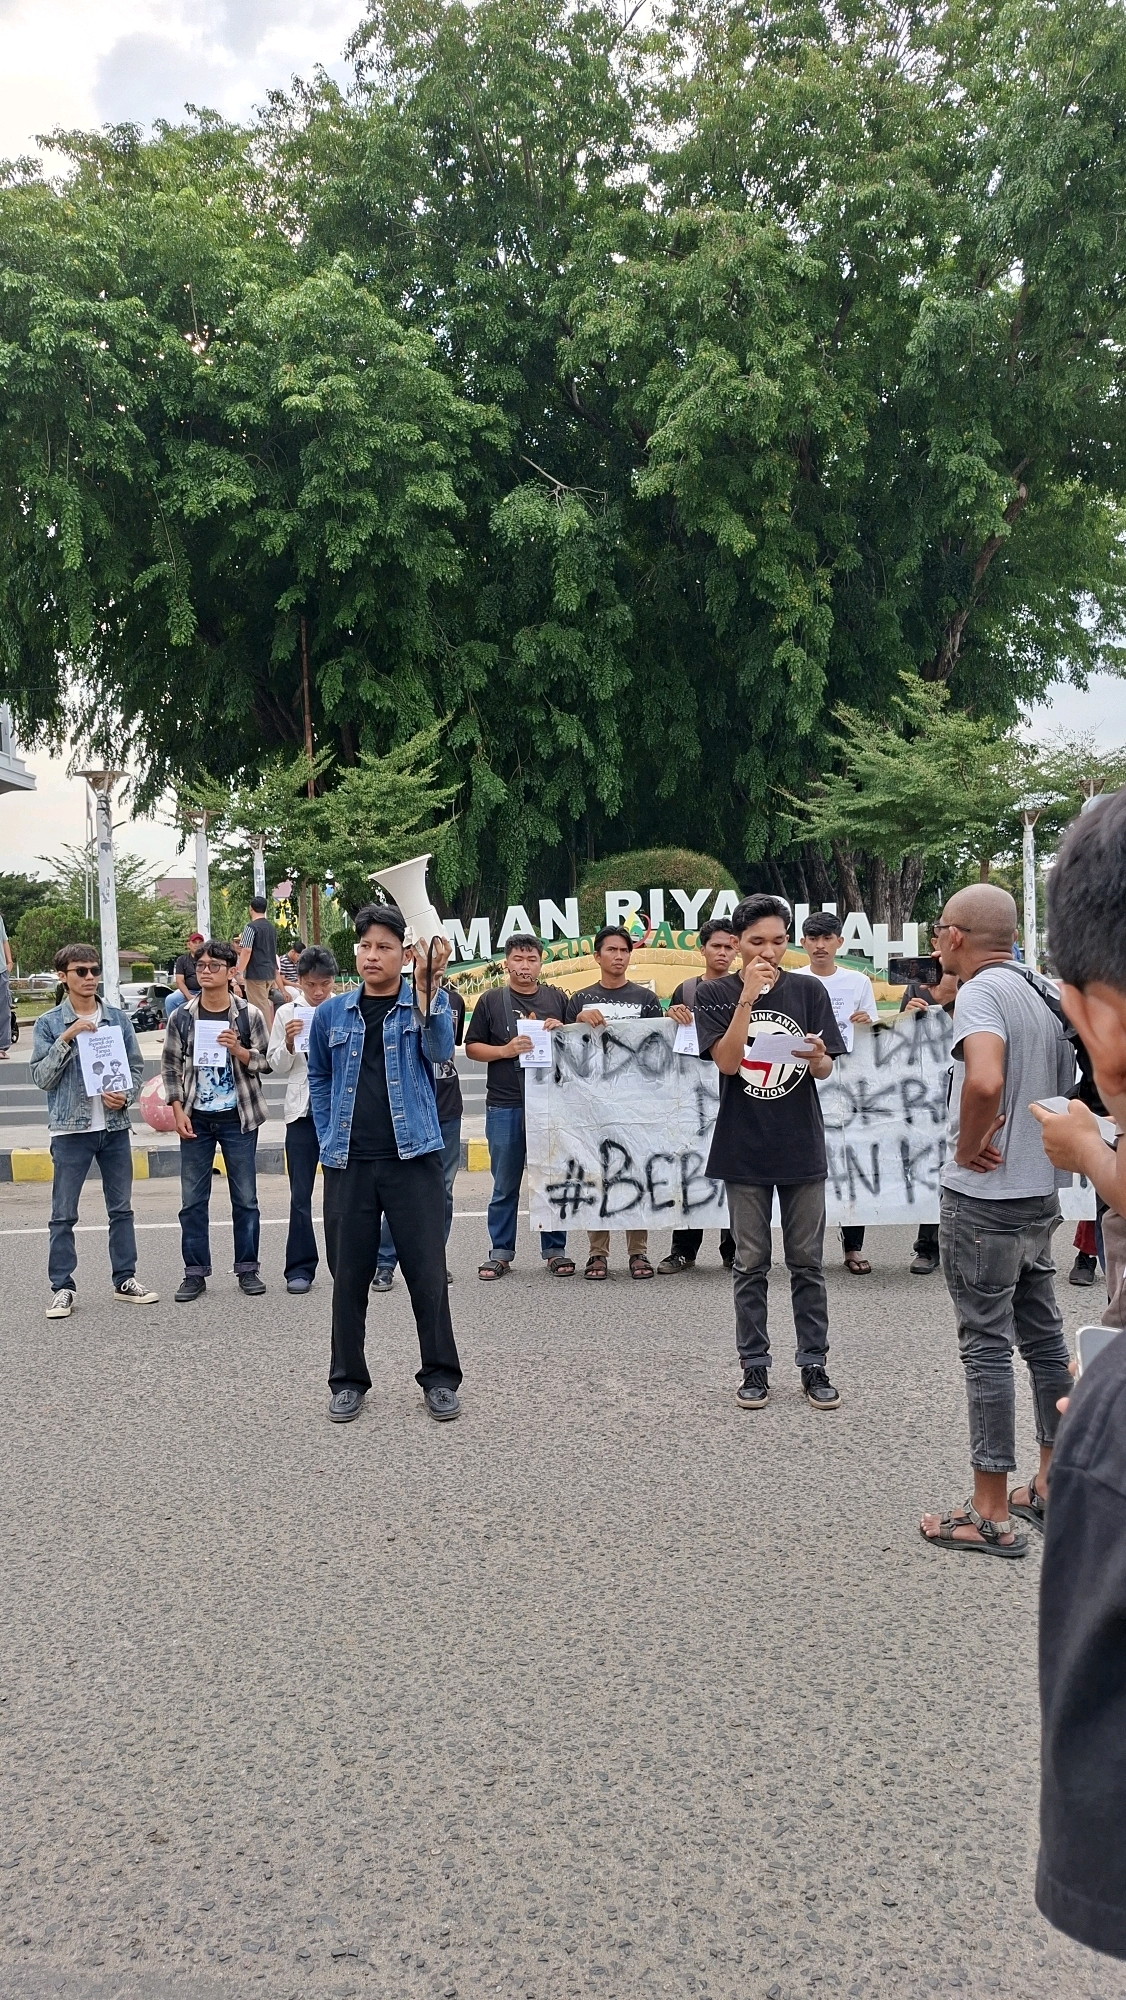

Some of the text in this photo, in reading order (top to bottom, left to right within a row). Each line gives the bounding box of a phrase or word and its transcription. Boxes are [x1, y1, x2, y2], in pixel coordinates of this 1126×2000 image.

[401, 889, 918, 973] MAN RIYAHAH
[751, 1012, 773, 1021] UNK
[744, 1084, 786, 1098] ACTION
